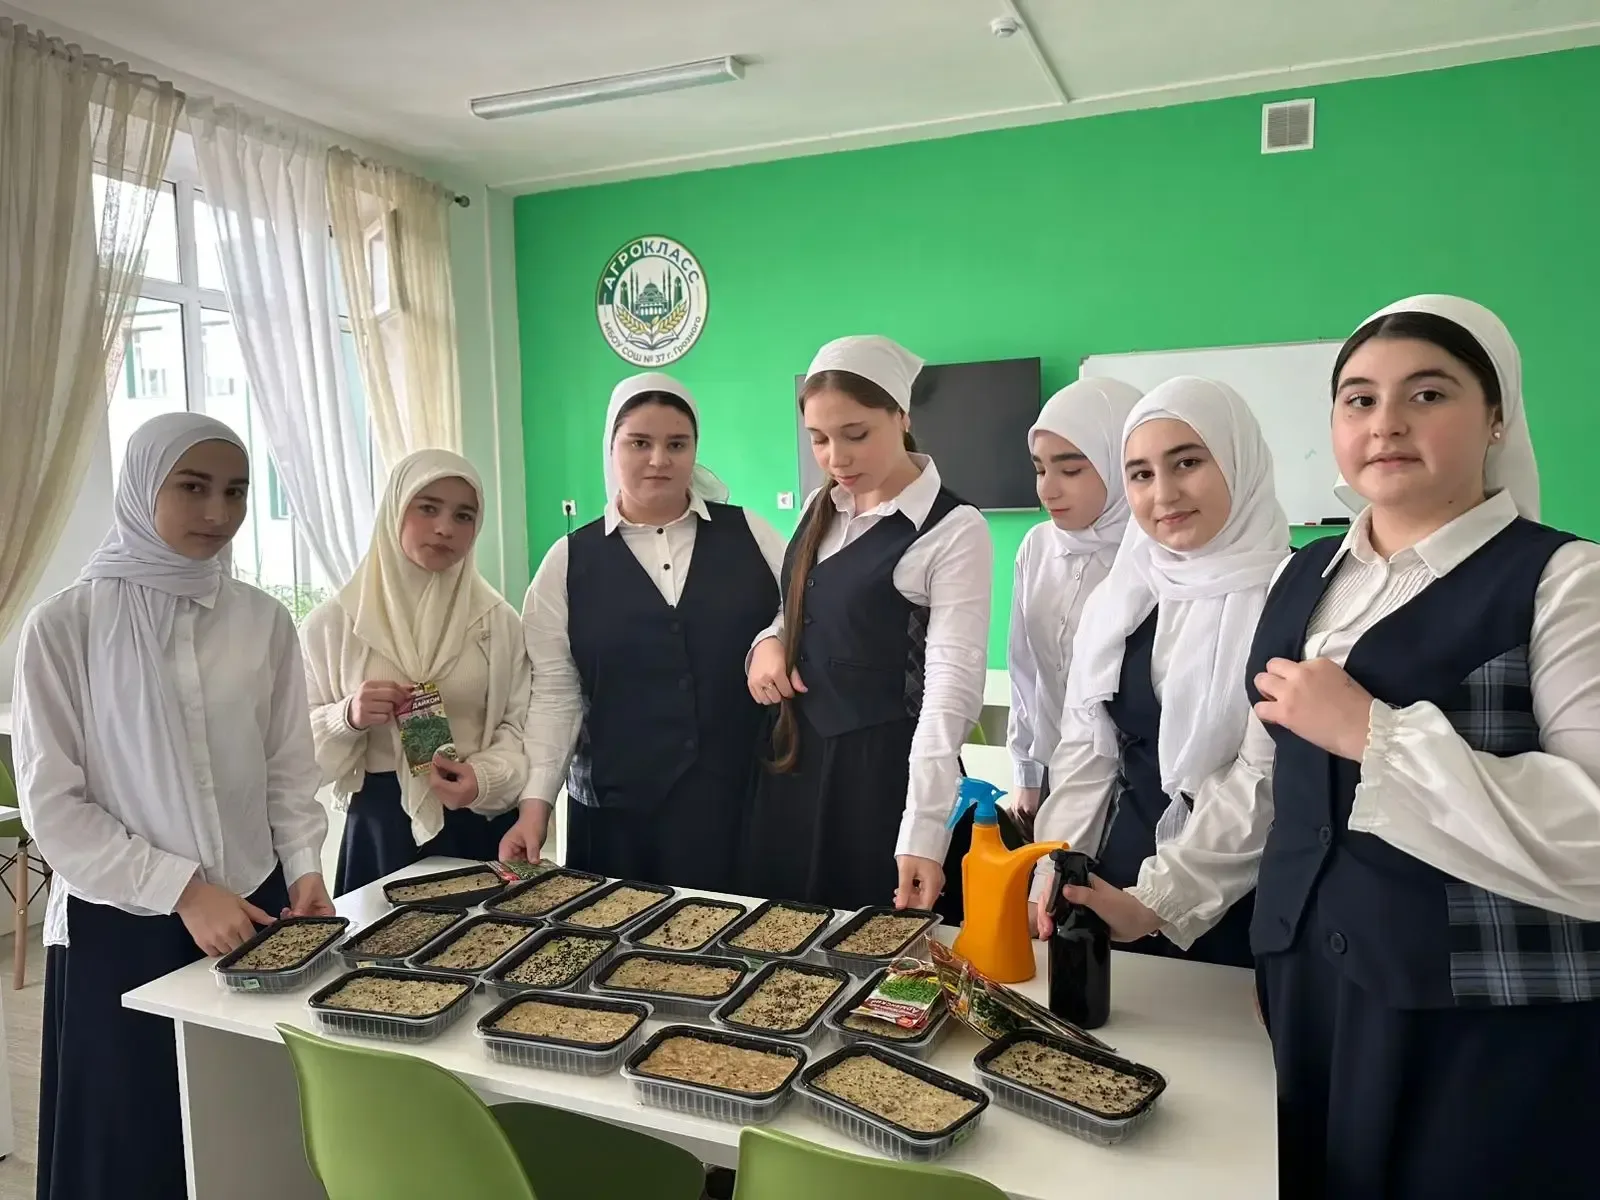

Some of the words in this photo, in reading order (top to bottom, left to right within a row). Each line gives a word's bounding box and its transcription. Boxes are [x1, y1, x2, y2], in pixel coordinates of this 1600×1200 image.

[603, 240, 700, 290] АГРОКЛАСС
[604, 322, 622, 348] МБОУ
[621, 346, 642, 361] СОШ
[655, 354, 665, 363] 37
[673, 316, 702, 354] Грозного
[412, 696, 440, 710] ДАЙКОН
